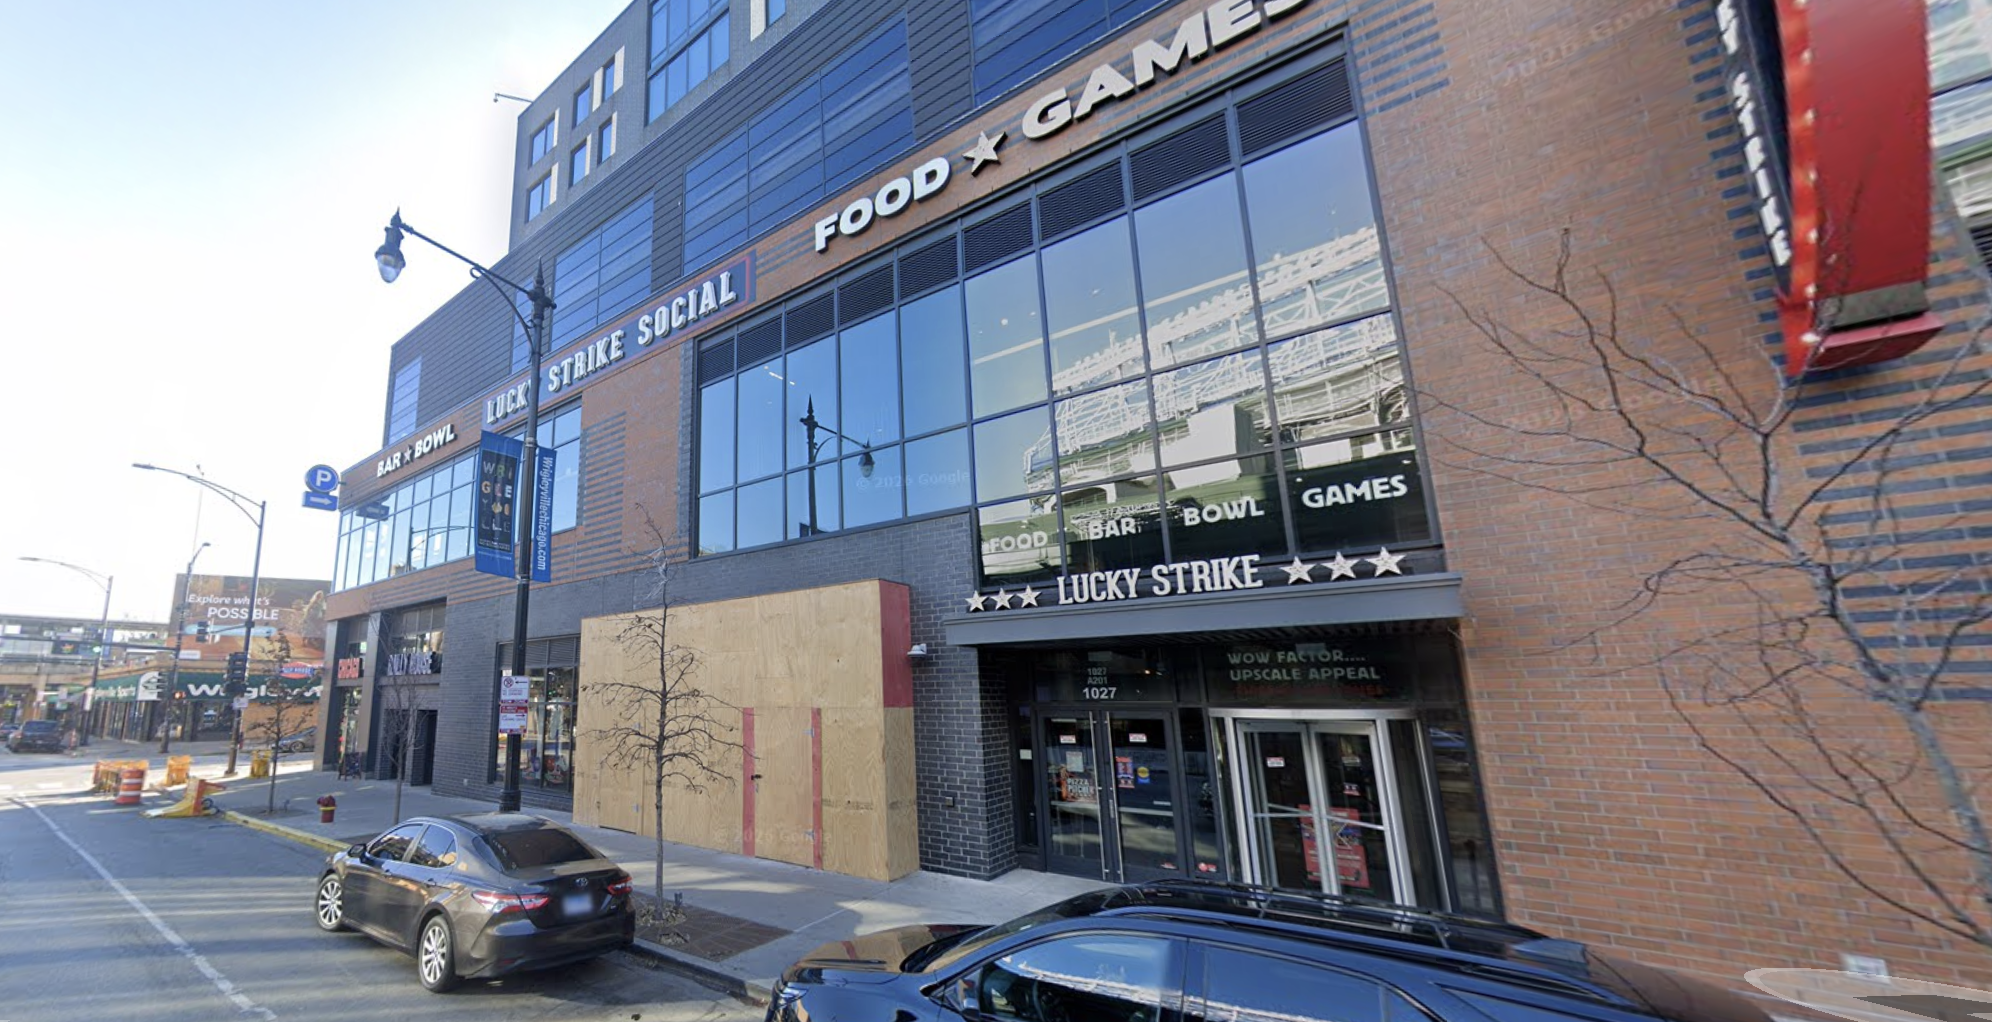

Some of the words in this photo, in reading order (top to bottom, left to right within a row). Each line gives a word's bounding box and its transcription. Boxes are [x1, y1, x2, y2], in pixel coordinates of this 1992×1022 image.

[814, 156, 951, 252] FOOD
[1022, 0, 1313, 140] GAME
[1733, 71, 1791, 266] STRIKE
[548, 329, 625, 392] STRIKE
[638, 270, 737, 345] SOCIAL
[377, 452, 402, 477] BAR
[415, 423, 456, 459] BOWL
[316, 470, 331, 486] P
[1302, 474, 1408, 508] GAMES
[537, 457, 554, 571] Wrigleyvillechicago.com
[1183, 496, 1265, 527] BOWL
[989, 531, 1048, 552] FOOD
[1089, 518, 1136, 540] BAR
[1057, 567, 1141, 605] LUCKY
[1151, 555, 1263, 596] STRIKE
[188, 594, 231, 606] Explore
[234, 595, 270, 606] wht's
[207, 607, 279, 620] POSSBLE
[1228, 652, 1270, 665] WOW
[1230, 668, 1301, 681] UPSCALE
[1308, 667, 1380, 680] APPEAL
[1082, 687, 1117, 700] 1027
